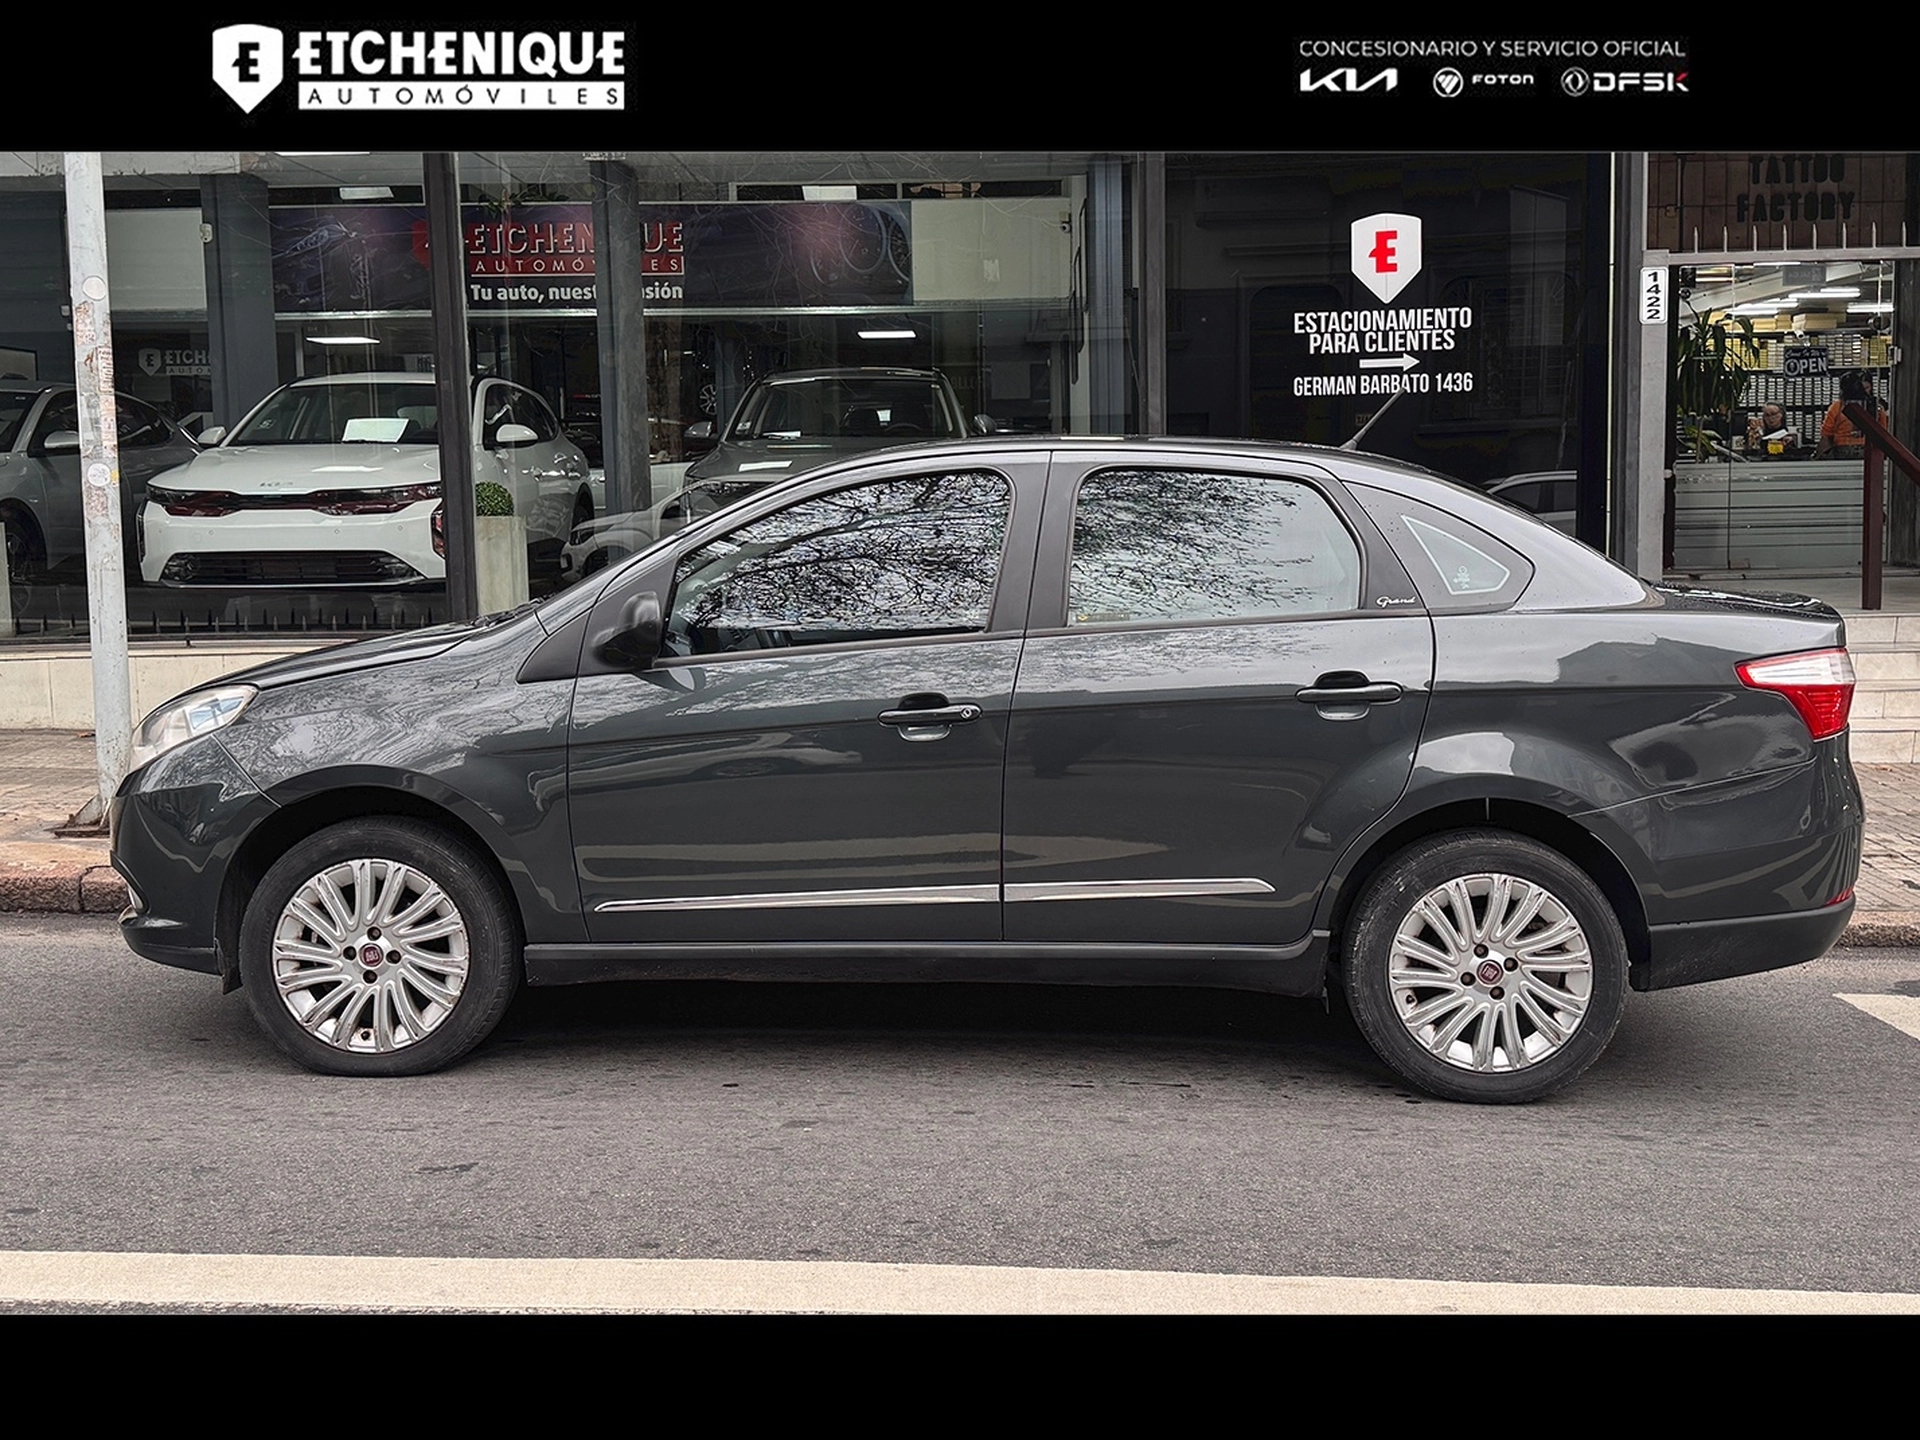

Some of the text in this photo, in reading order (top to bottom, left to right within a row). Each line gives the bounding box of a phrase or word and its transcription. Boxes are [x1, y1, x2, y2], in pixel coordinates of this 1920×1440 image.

[1736, 192, 1855, 222] FACTORY
[465, 221, 684, 254] ETCHENUE
[475, 257, 679, 273] AUTOMÓES
[470, 284, 493, 301] Tu
[496, 284, 545, 303] auto,
[1646, 270, 1662, 320] 1422
[1293, 306, 1473, 334] ESTACIONAMIENTO
[1309, 328, 1456, 355] PARA CLIENTES
[1784, 356, 1828, 377] OPEN
[1293, 371, 1474, 397] GERMAN BARBATO 1436
[1376, 596, 1416, 608] Grand
